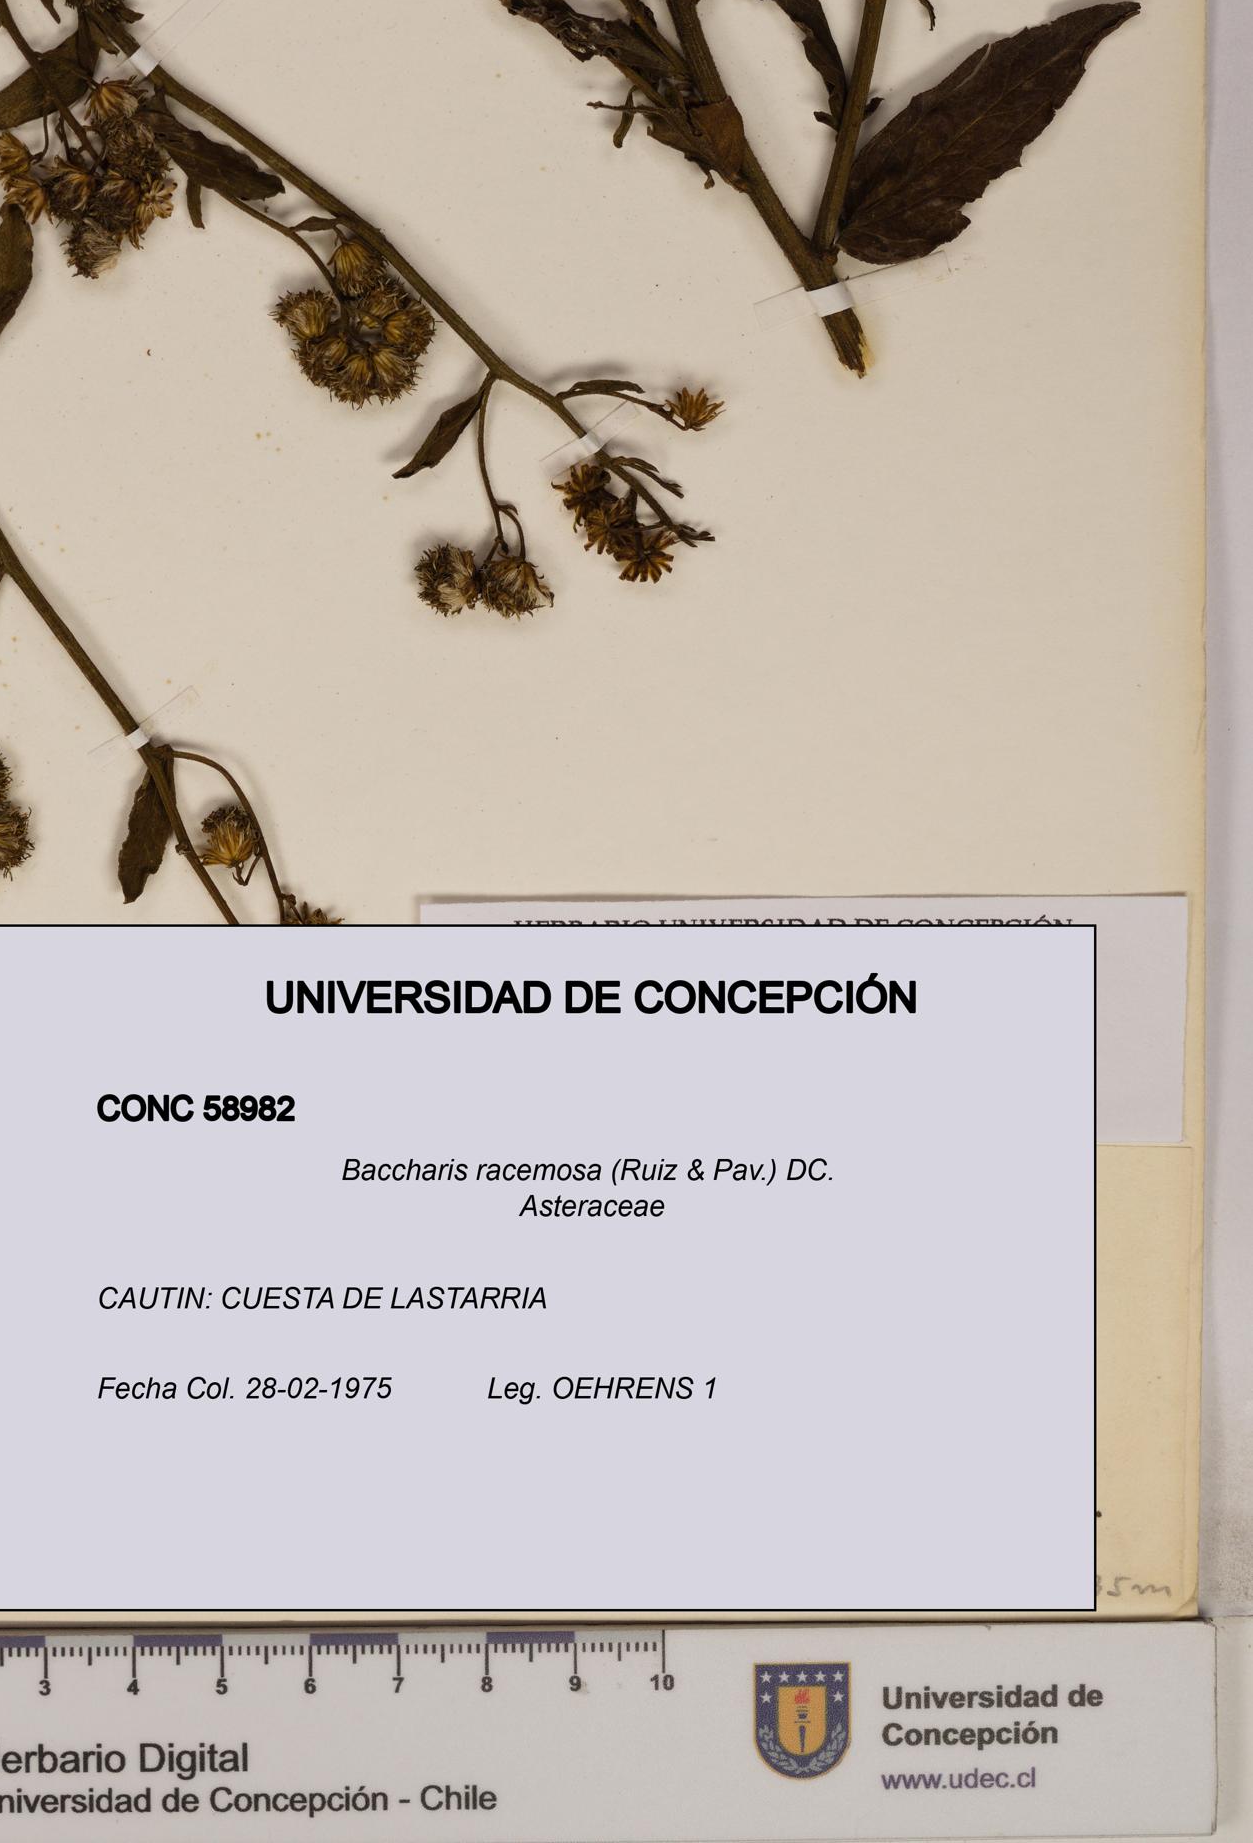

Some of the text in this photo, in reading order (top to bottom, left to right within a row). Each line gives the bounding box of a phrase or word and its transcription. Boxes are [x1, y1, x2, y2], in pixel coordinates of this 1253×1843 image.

[38, 1679, 52, 1696] 3
[126, 1679, 140, 1696] 4
[215, 1678, 228, 1695] 5
[303, 1678, 317, 1695] 6
[392, 1677, 405, 1694] 7
[480, 1676, 493, 1693] 8
[568, 1675, 582, 1692] 9
[649, 1674, 675, 1691] 10
[882, 1683, 1104, 1710] Universidad de
[881, 1720, 1059, 1751] Concepción
[139, 1742, 249, 1781] Digital
[880, 1766, 1037, 1790] www.udec.cl
[161, 1787, 200, 1813] de
[209, 1785, 389, 1819] Concepción
[420, 1784, 498, 1811] Chile
